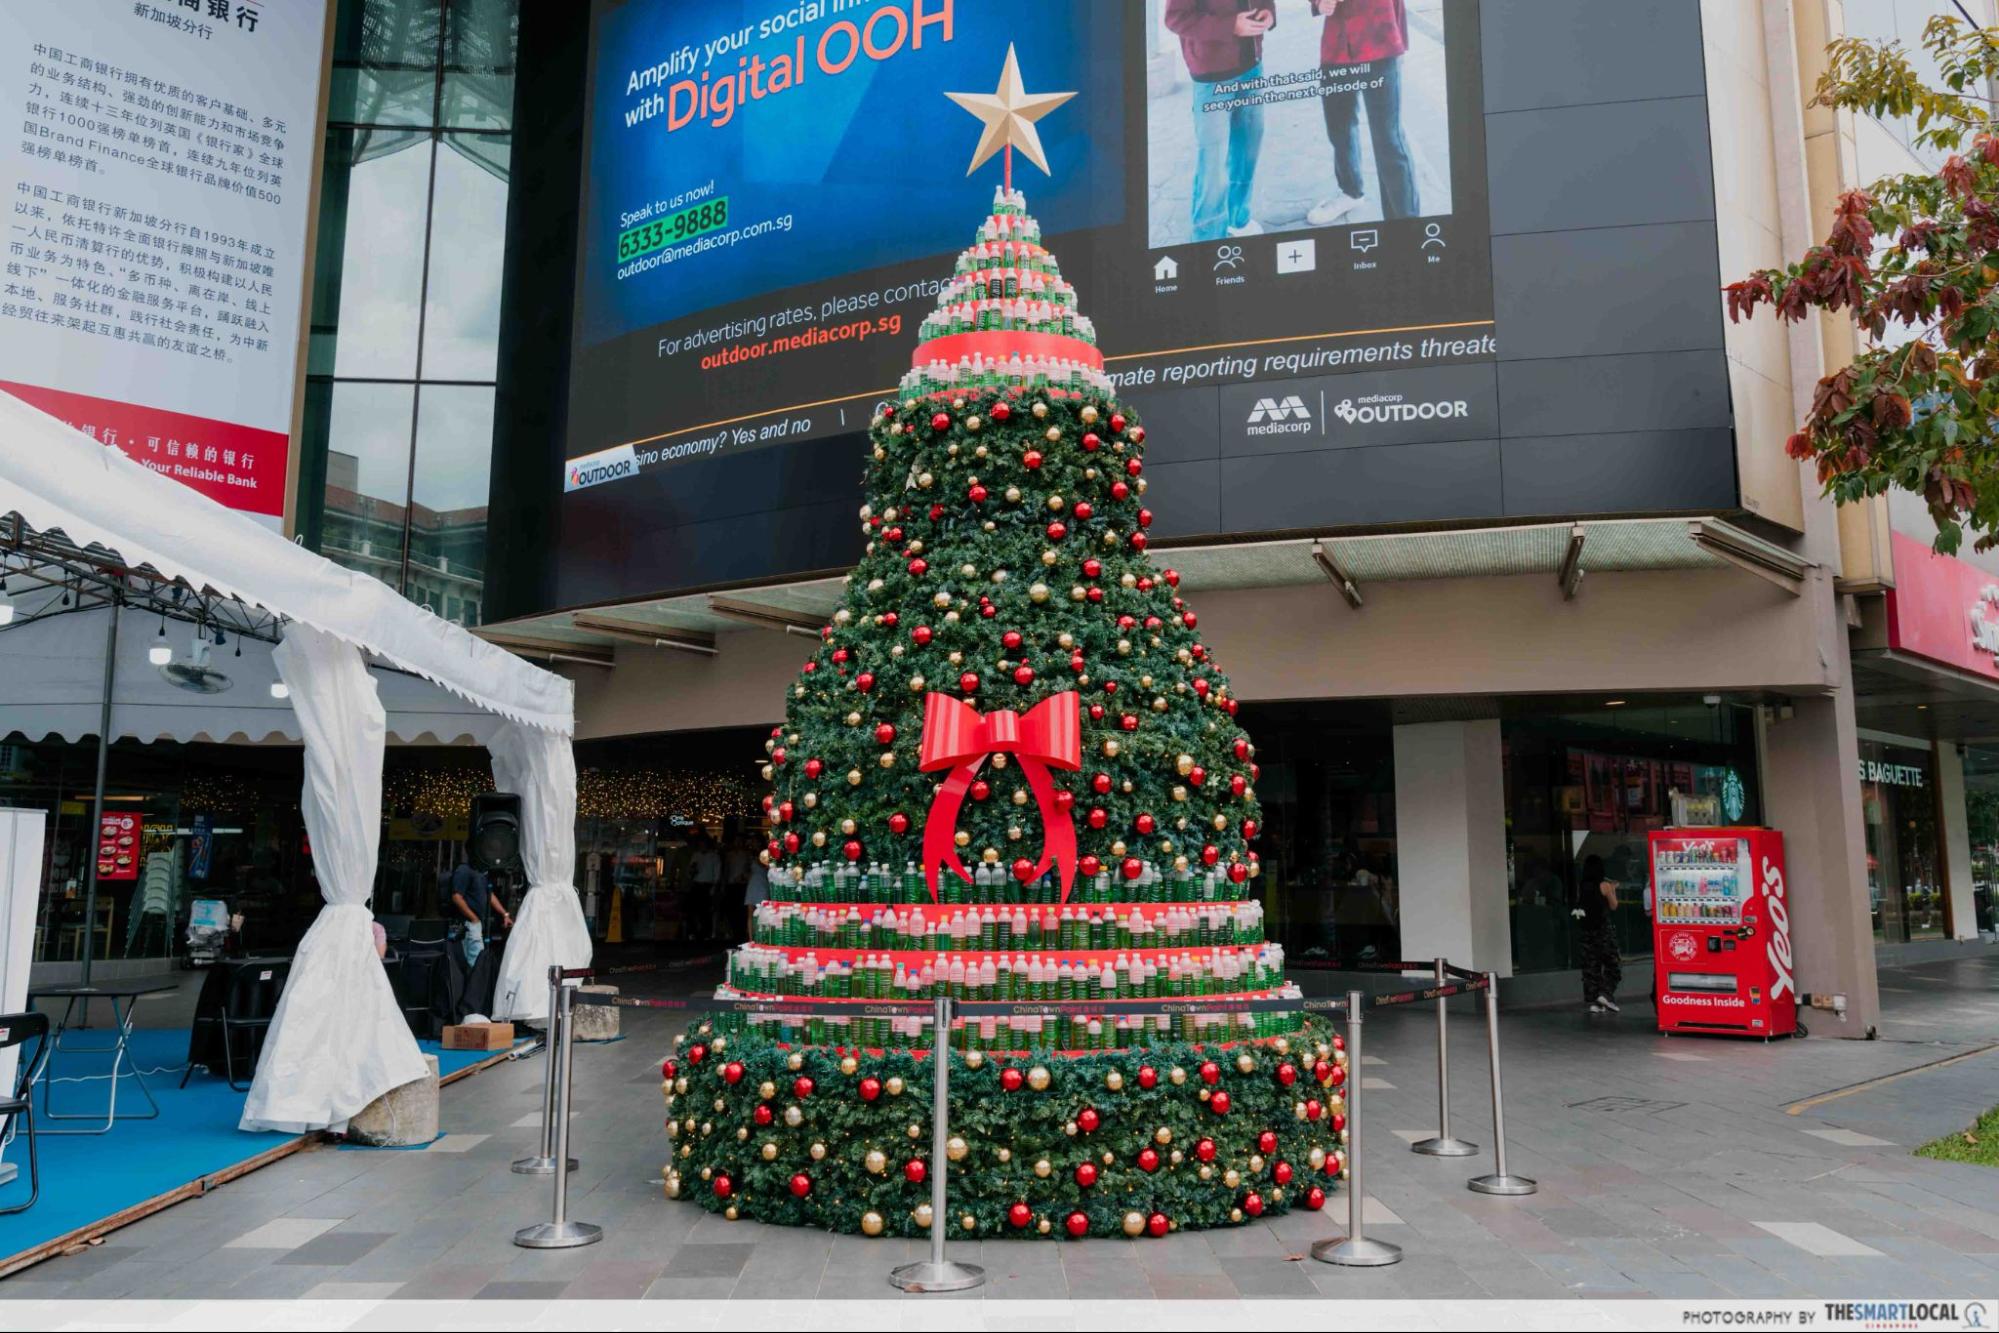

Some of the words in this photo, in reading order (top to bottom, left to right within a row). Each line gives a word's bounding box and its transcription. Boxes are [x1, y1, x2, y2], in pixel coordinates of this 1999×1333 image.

[134, 2, 213, 40] 新加坡分行
[627, 46, 699, 95] Amplify
[704, 26, 753, 65] your
[759, 0, 826, 39] social
[625, 94, 664, 128] with
[667, 35, 805, 132] Digital
[816, 0, 954, 75] OOH
[1214, 83, 1239, 95] And
[1241, 79, 1268, 91] with
[1269, 75, 1295, 87] that
[1298, 69, 1327, 82] said,
[1328, 68, 1347, 78] we
[1349, 63, 1371, 75] will
[1203, 102, 1225, 113] see
[1226, 99, 1249, 112] you
[1251, 95, 1263, 105] in
[1264, 92, 1286, 103] the
[1288, 87, 1316, 100] next
[1317, 79, 1368, 97] episode
[1370, 77, 1385, 88] of
[17, 181, 275, 259] 中国工商银行新加坡分行自1993年成立
[620, 203, 652, 229] Speak
[654, 199, 668, 215] to
[669, 194, 683, 209] us
[685, 179, 714, 203] now!
[619, 200, 726, 259] 6333-9888
[617, 214, 793, 280] outdoor@mediacorp.com.sg
[1427, 255, 1441, 263] Me
[1215, 275, 1245, 286] Friends
[1353, 261, 1377, 270] Inbox
[1155, 284, 1178, 294] Home
[658, 338, 682, 357] For
[683, 315, 767, 352] advertising
[769, 303, 817, 329] rates,
[821, 290, 879, 318] please
[884, 278, 955, 304] contac
[700, 314, 902, 371] outdoor.mediacorp.sg
[1162, 355, 1257, 385] reporting
[1264, 340, 1413, 374] requirements
[1357, 399, 1468, 424] OUTDOOR
[1358, 393, 1403, 404] mediacorp
[661, 431, 728, 461] economy?
[732, 427, 757, 446] Yes
[760, 418, 789, 439] and
[791, 417, 812, 434] no
[1247, 421, 1312, 436] mediacorp
[141, 458, 171, 474] Your
[174, 464, 225, 483] Reliable
[227, 473, 257, 489] Bank
[578, 460, 631, 485] OUTDOOR
[1867, 760, 1924, 788] BAGUETTE
[1761, 855, 1796, 1000] Yeo's
[1302, 1000, 1350, 1009] ChinaTown
[1662, 993, 1712, 1007] Goodness
[1713, 995, 1745, 1008] Inside
